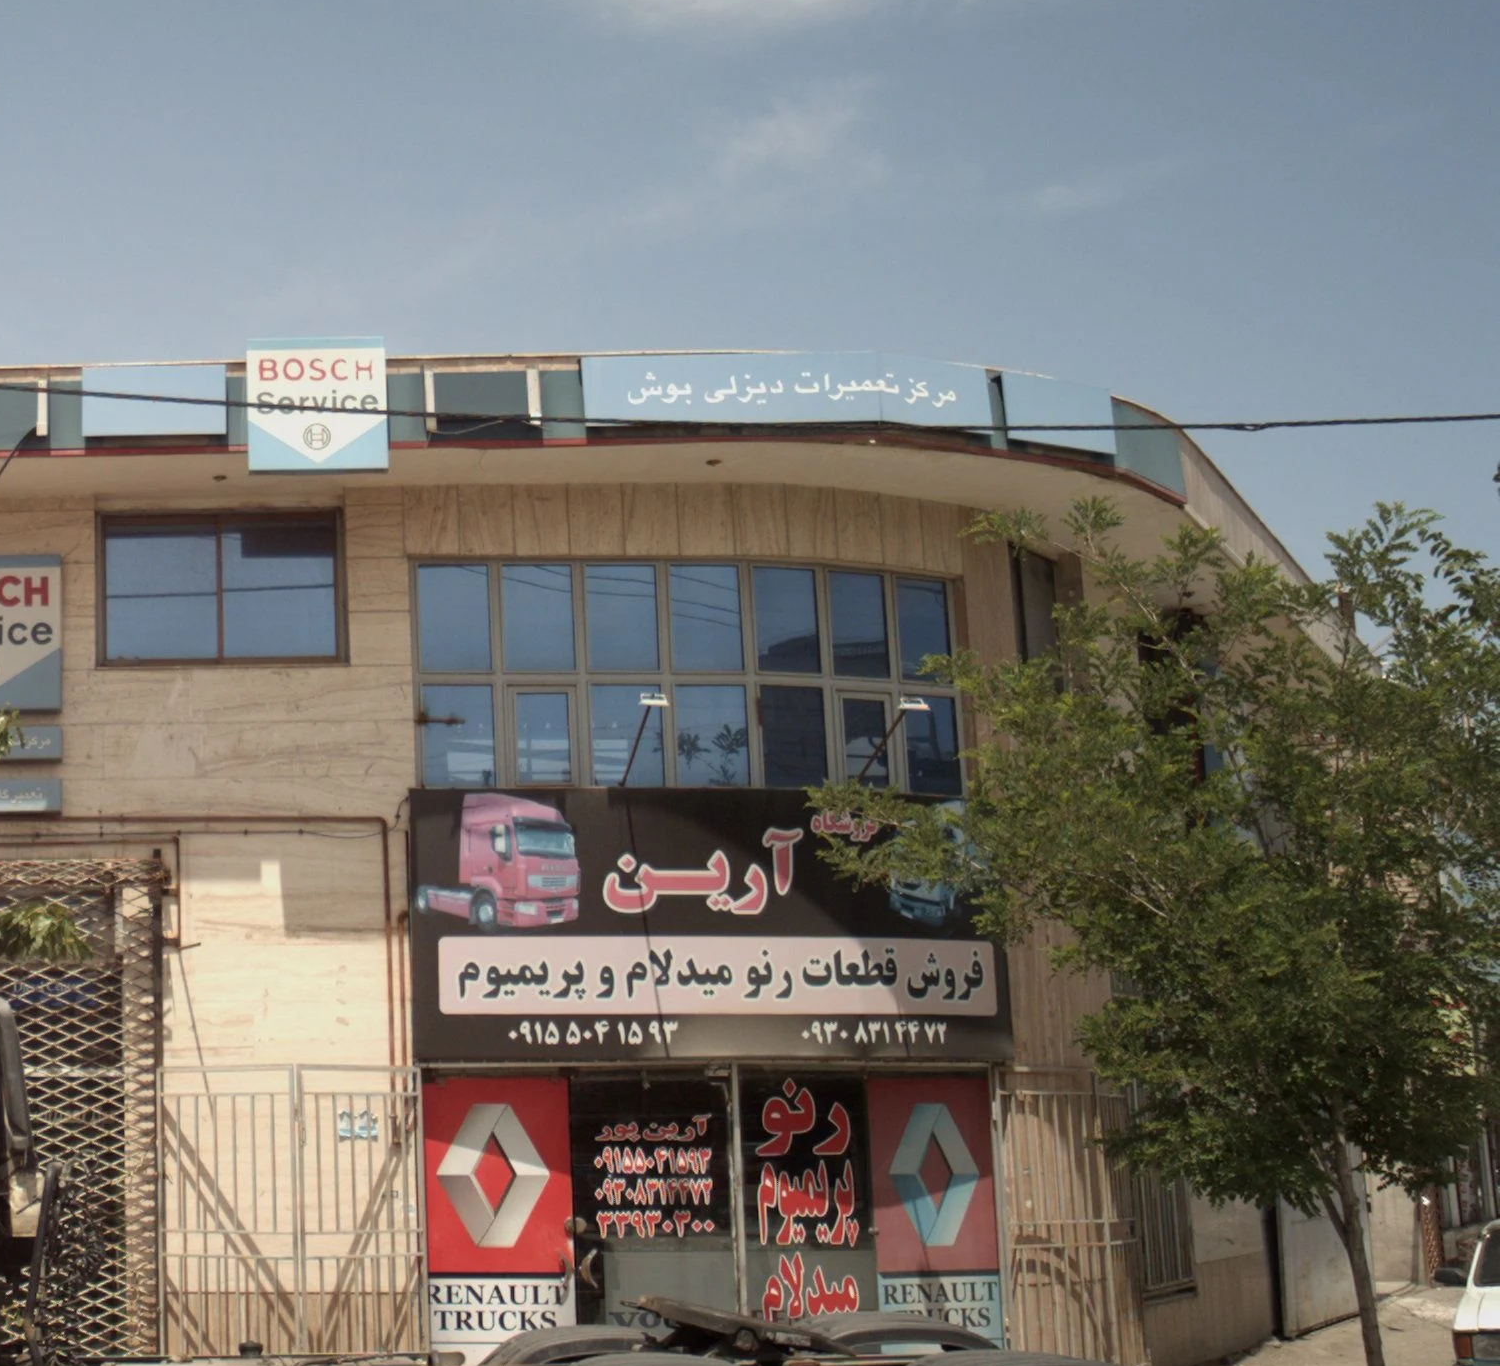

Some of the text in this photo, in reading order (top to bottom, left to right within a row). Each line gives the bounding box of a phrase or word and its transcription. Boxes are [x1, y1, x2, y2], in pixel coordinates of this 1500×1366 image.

[258, 358, 373, 381] BOSCH
[256, 389, 379, 415] Service
[627, 371, 957, 407] مرکز تعمیرات دیزلی بوش
[602, 826, 804, 916] آرین
[458, 947, 984, 1001] فروش قطعات رنو میدلام و پریمیوم
[508, 1020, 679, 1046] ۰۹۱۵ ۵۰۴ ۱۵ ۹۳
[801, 1020, 848, 1044] ۰۹۳۰
[854, 1021, 890, 1044] ۸۳۱
[924, 1021, 948, 1044] ۷۲
[594, 1113, 712, 1143] آرین پور
[755, 1077, 851, 1157] رنو
[594, 1146, 712, 1175] ۰۹۱۵۵۰۴۱۵۹۳
[594, 1178, 713, 1206] ۰۹۳۰۸۳۱۴۴۷۲
[757, 1159, 860, 1248] پریمیوم
[596, 1210, 715, 1239] ۳۳۹۳۰۳۰۰
[428, 1284, 567, 1307] RENAULT
[883, 1281, 998, 1305] RENAULT
[434, 1310, 558, 1333] TRUCKS
